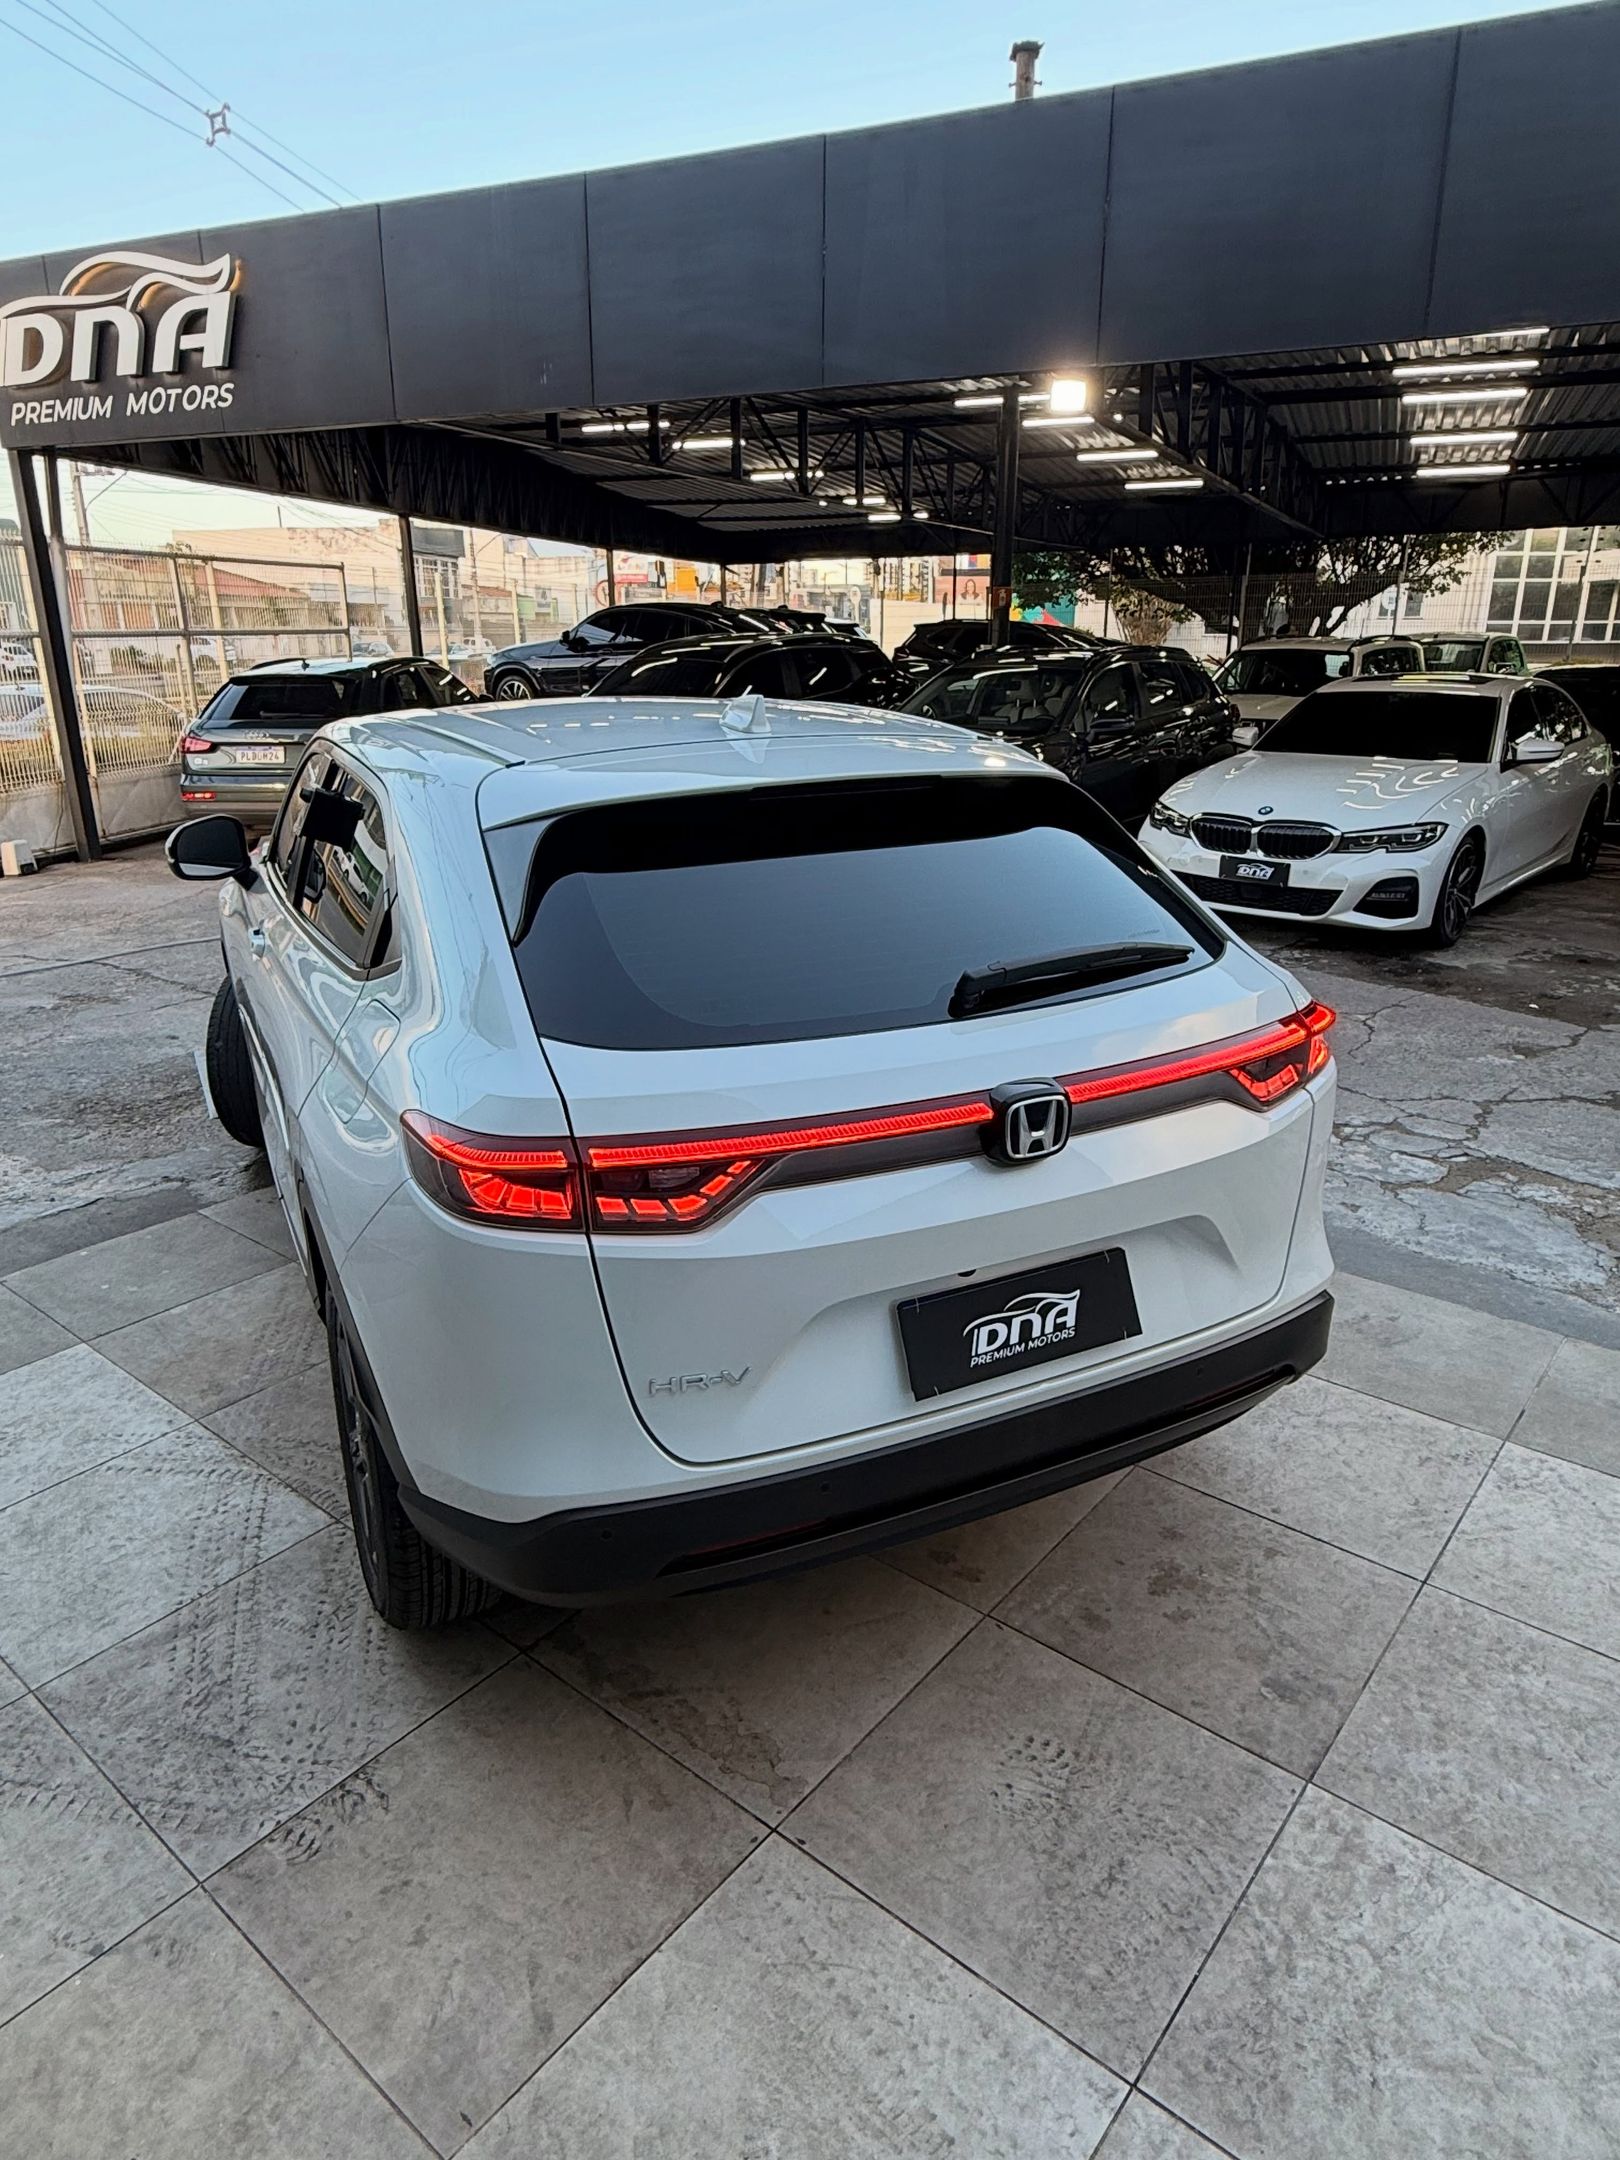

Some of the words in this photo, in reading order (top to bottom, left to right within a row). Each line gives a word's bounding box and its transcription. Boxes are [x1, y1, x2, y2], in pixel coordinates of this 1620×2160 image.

[11, 395, 114, 427] PREMIUM
[125, 382, 235, 416] MOTORS
[969, 1342, 1025, 1368] PREMIUM
[1027, 1327, 1076, 1350] MOTORS
[648, 1366, 752, 1396] HR-V
